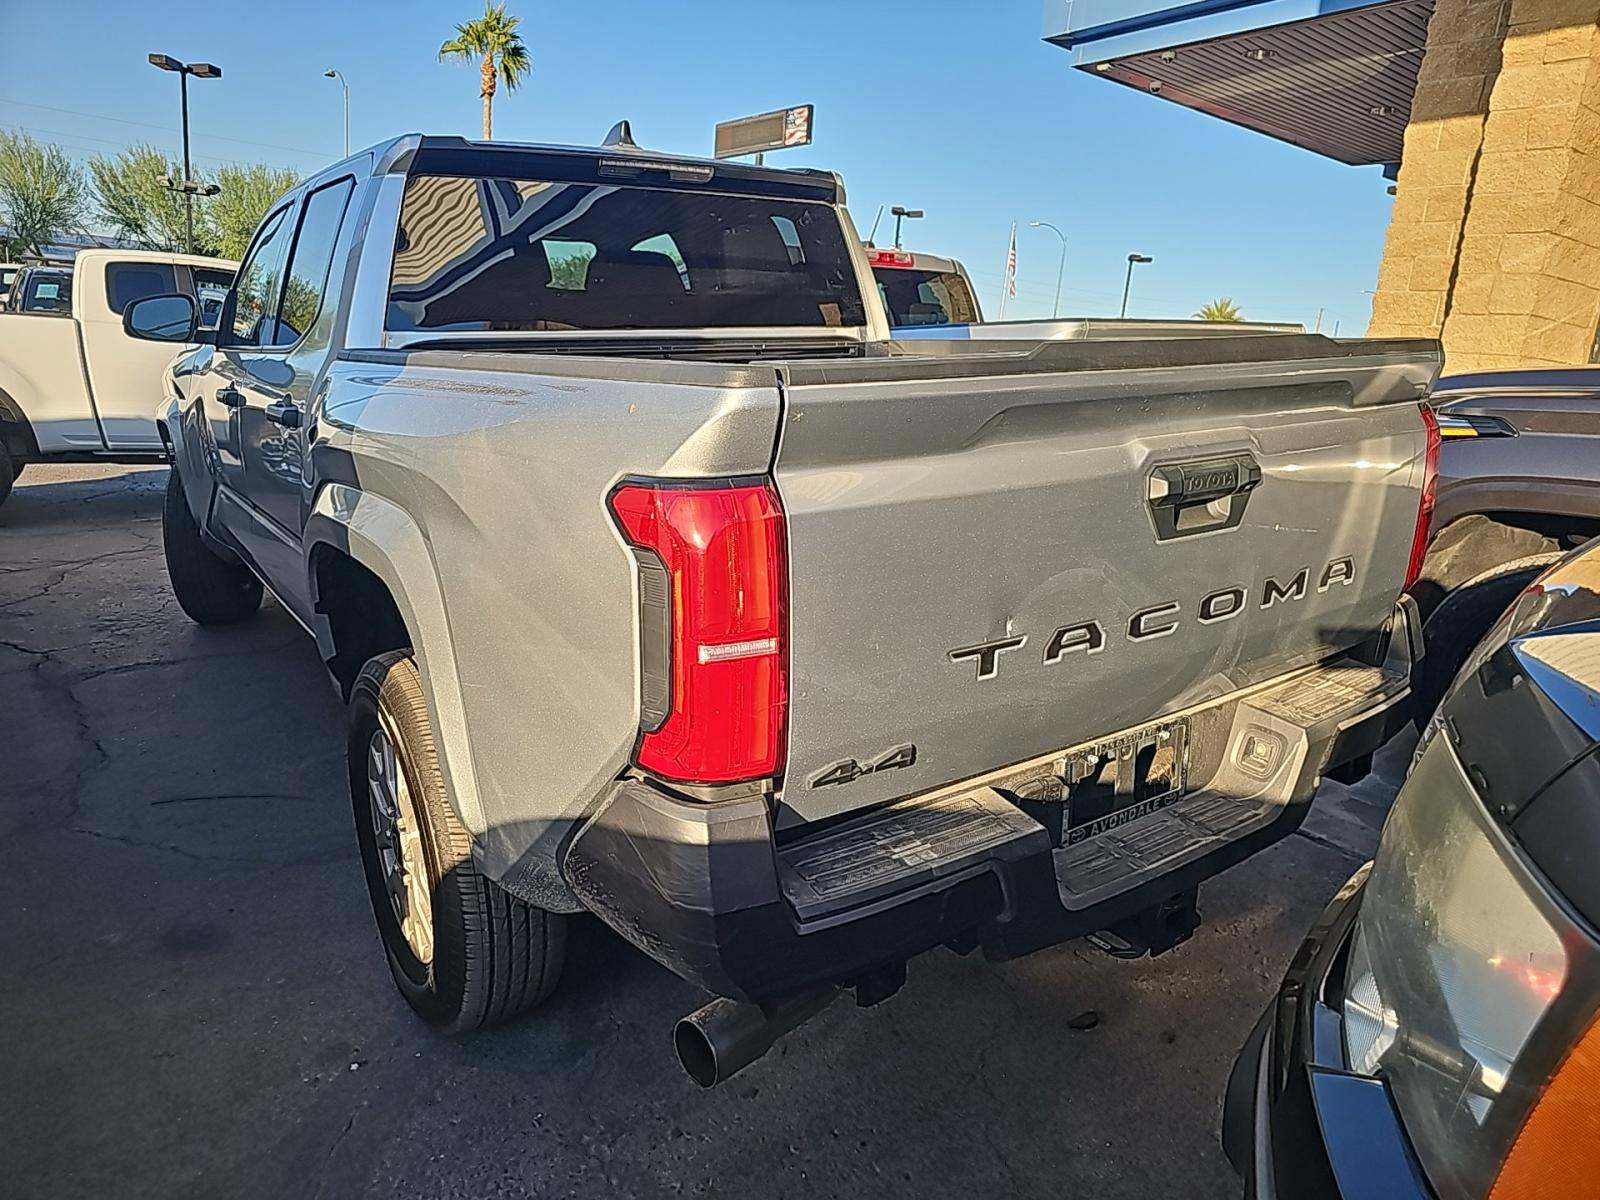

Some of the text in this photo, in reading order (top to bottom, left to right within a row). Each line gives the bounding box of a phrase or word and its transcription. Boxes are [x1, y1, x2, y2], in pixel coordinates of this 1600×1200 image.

[1187, 471, 1237, 491] TOYOTA
[947, 554, 1356, 681] TACOMA
[1090, 799, 1162, 837] AVONDALE
